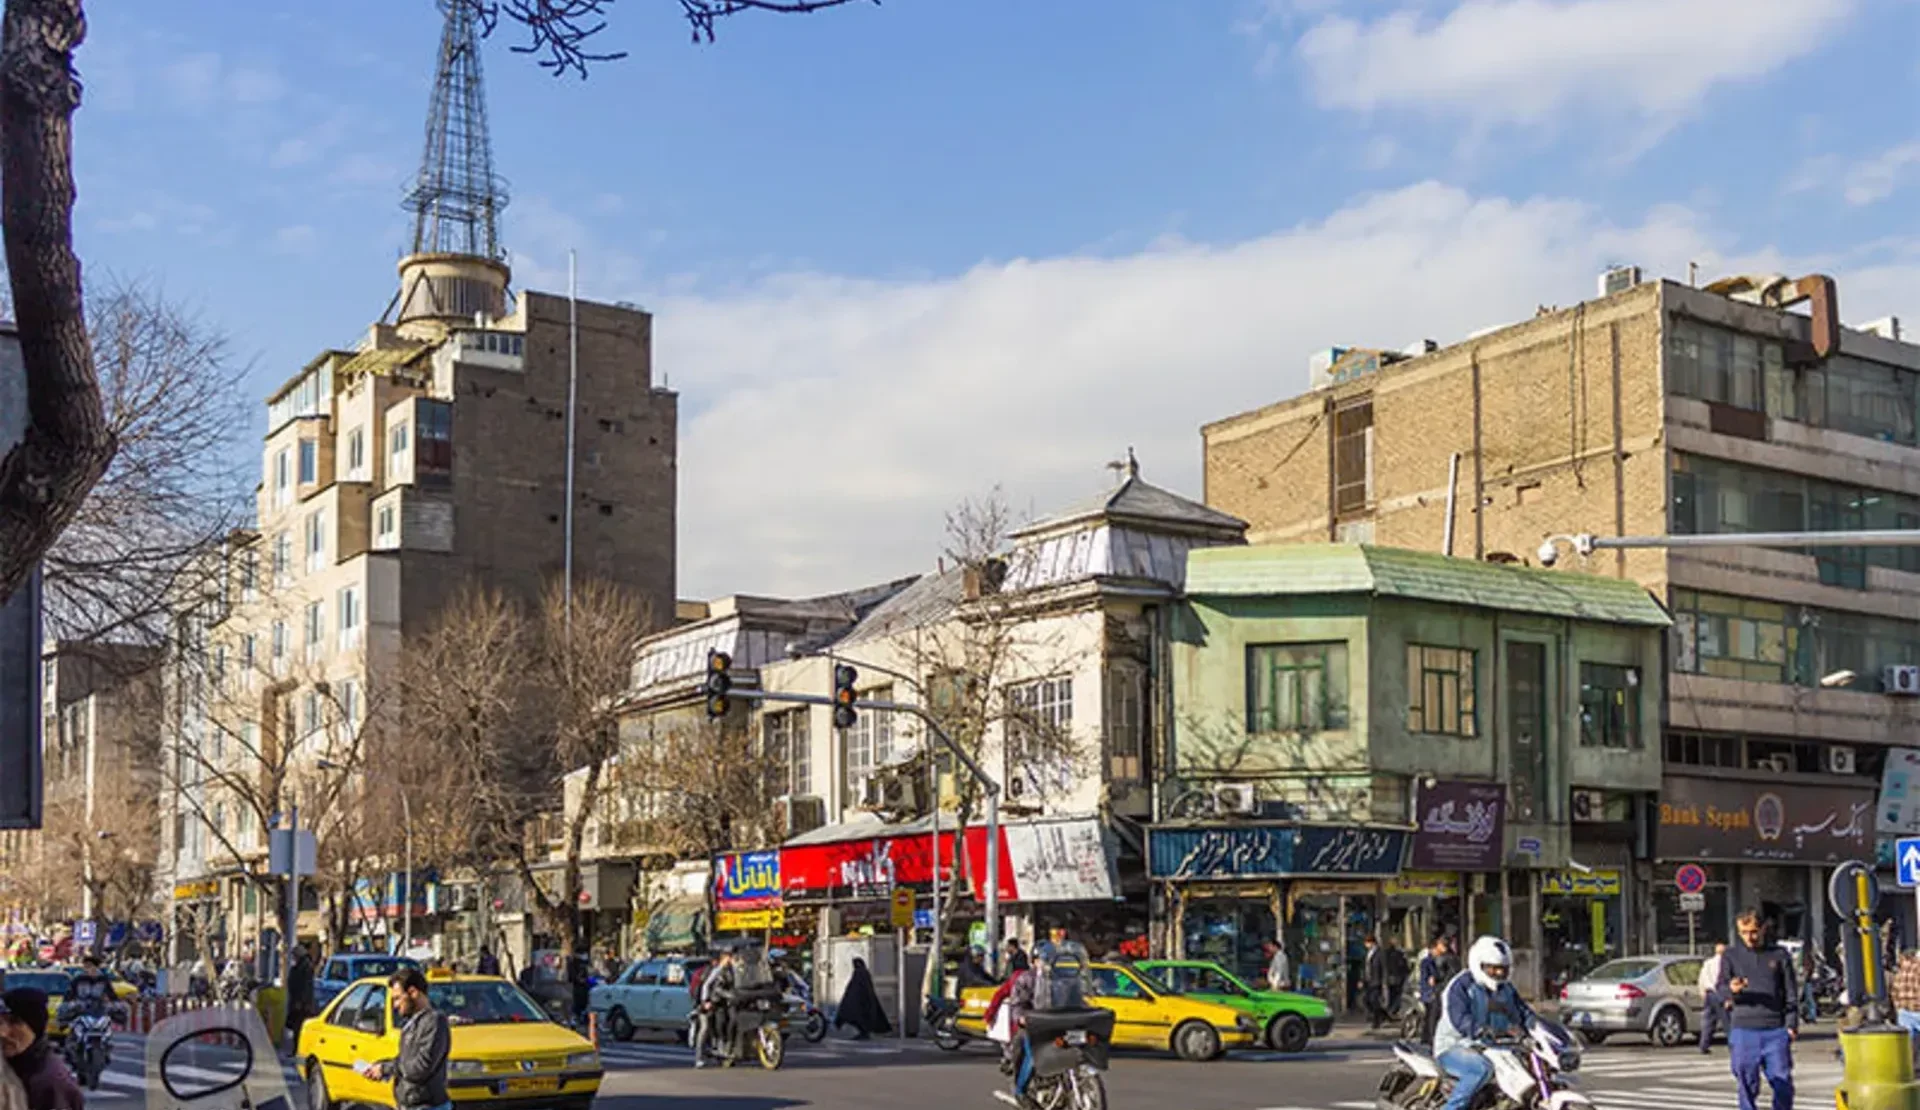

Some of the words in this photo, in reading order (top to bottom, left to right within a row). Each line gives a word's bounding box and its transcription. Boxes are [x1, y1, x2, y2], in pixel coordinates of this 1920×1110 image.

[1659, 803, 1700, 825] Bank
[1705, 806, 1750, 832] Sepah
[1791, 811, 1837, 849] سپه
[1831, 799, 1872, 845] بانک
